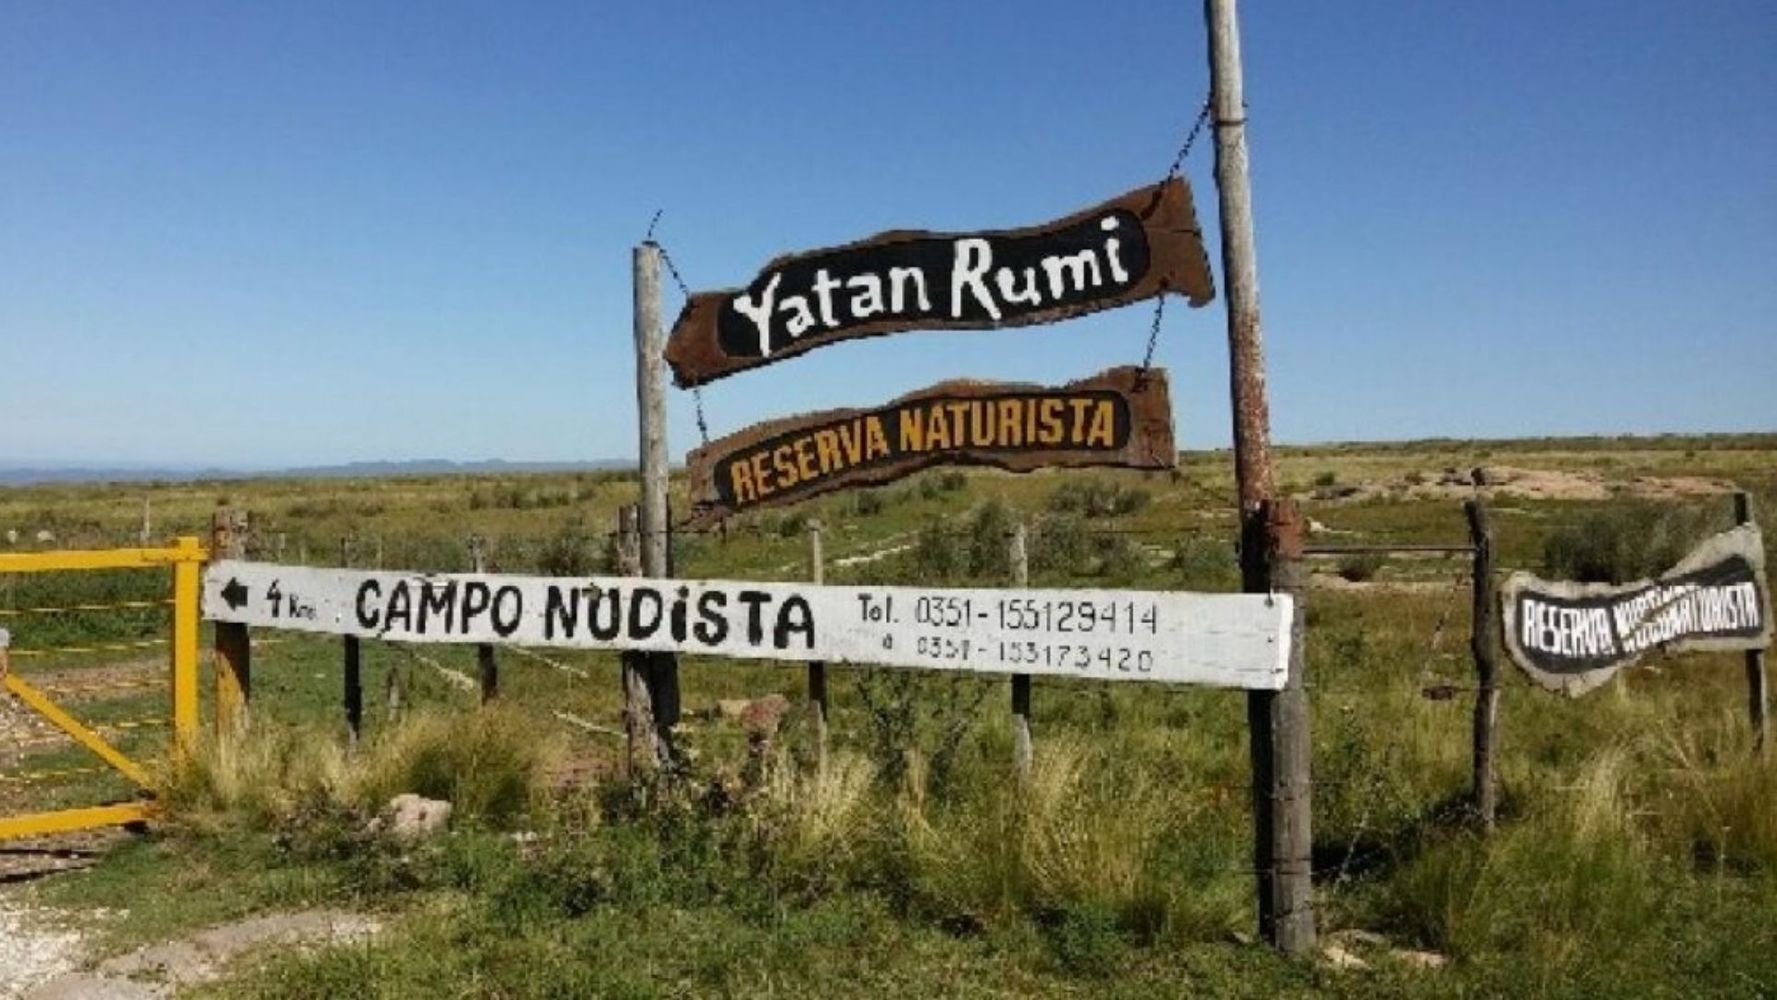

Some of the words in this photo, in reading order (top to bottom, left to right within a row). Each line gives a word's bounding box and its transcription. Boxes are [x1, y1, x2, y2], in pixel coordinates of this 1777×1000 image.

[732, 266, 931, 357] Yatan
[951, 215, 1129, 321] Rumi
[730, 419, 888, 503] RESERVA
[900, 398, 1115, 452] NATURISTA
[266, 578, 282, 618] 4
[355, 578, 524, 638] CAMPO
